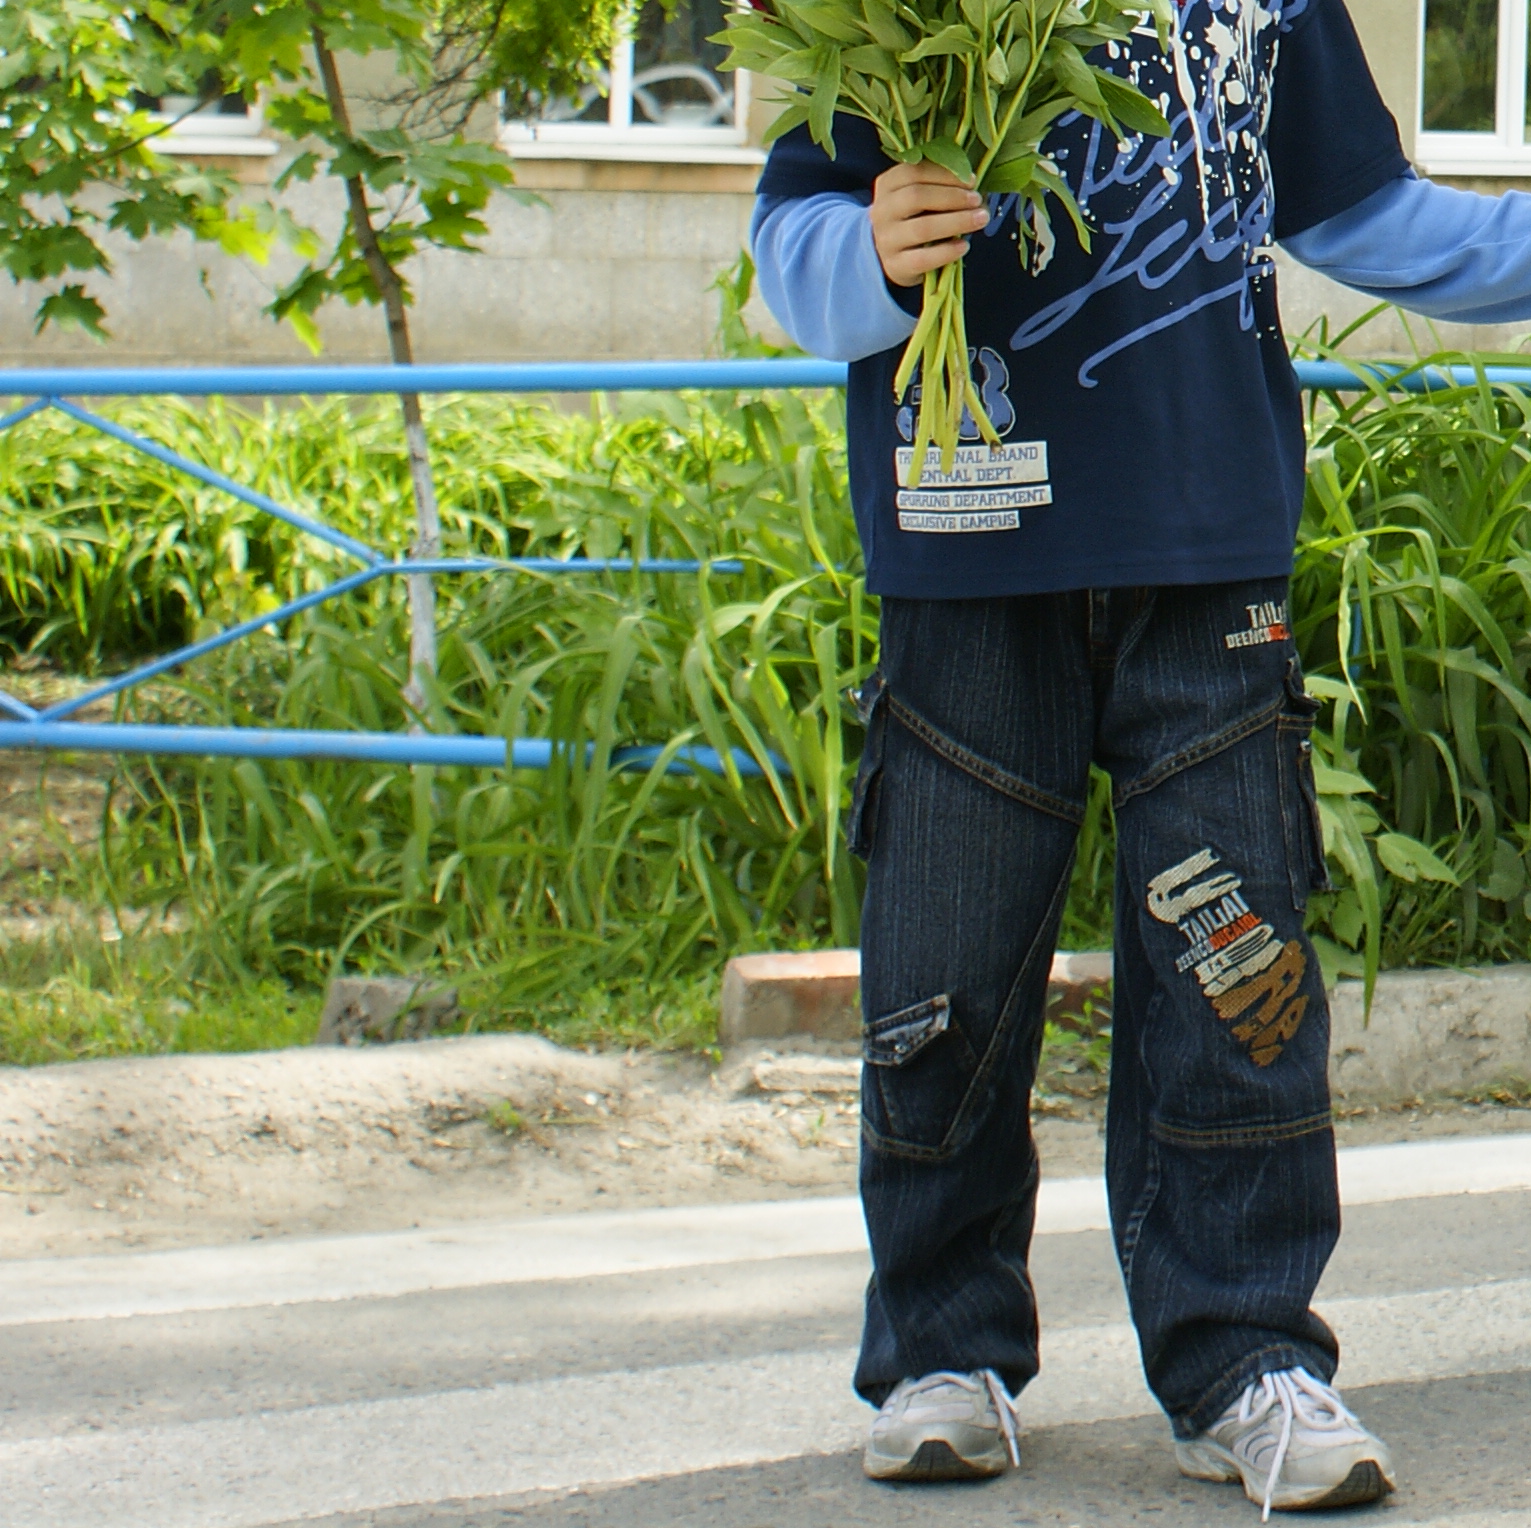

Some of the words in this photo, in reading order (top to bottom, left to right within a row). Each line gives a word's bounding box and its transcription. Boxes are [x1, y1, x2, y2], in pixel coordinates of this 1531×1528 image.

[988, 446, 1038, 463] BRAND
[919, 469, 971, 483] ENTRAL
[954, 488, 1045, 508] DEPARTMENT
[960, 513, 1017, 530] CAMPUS
